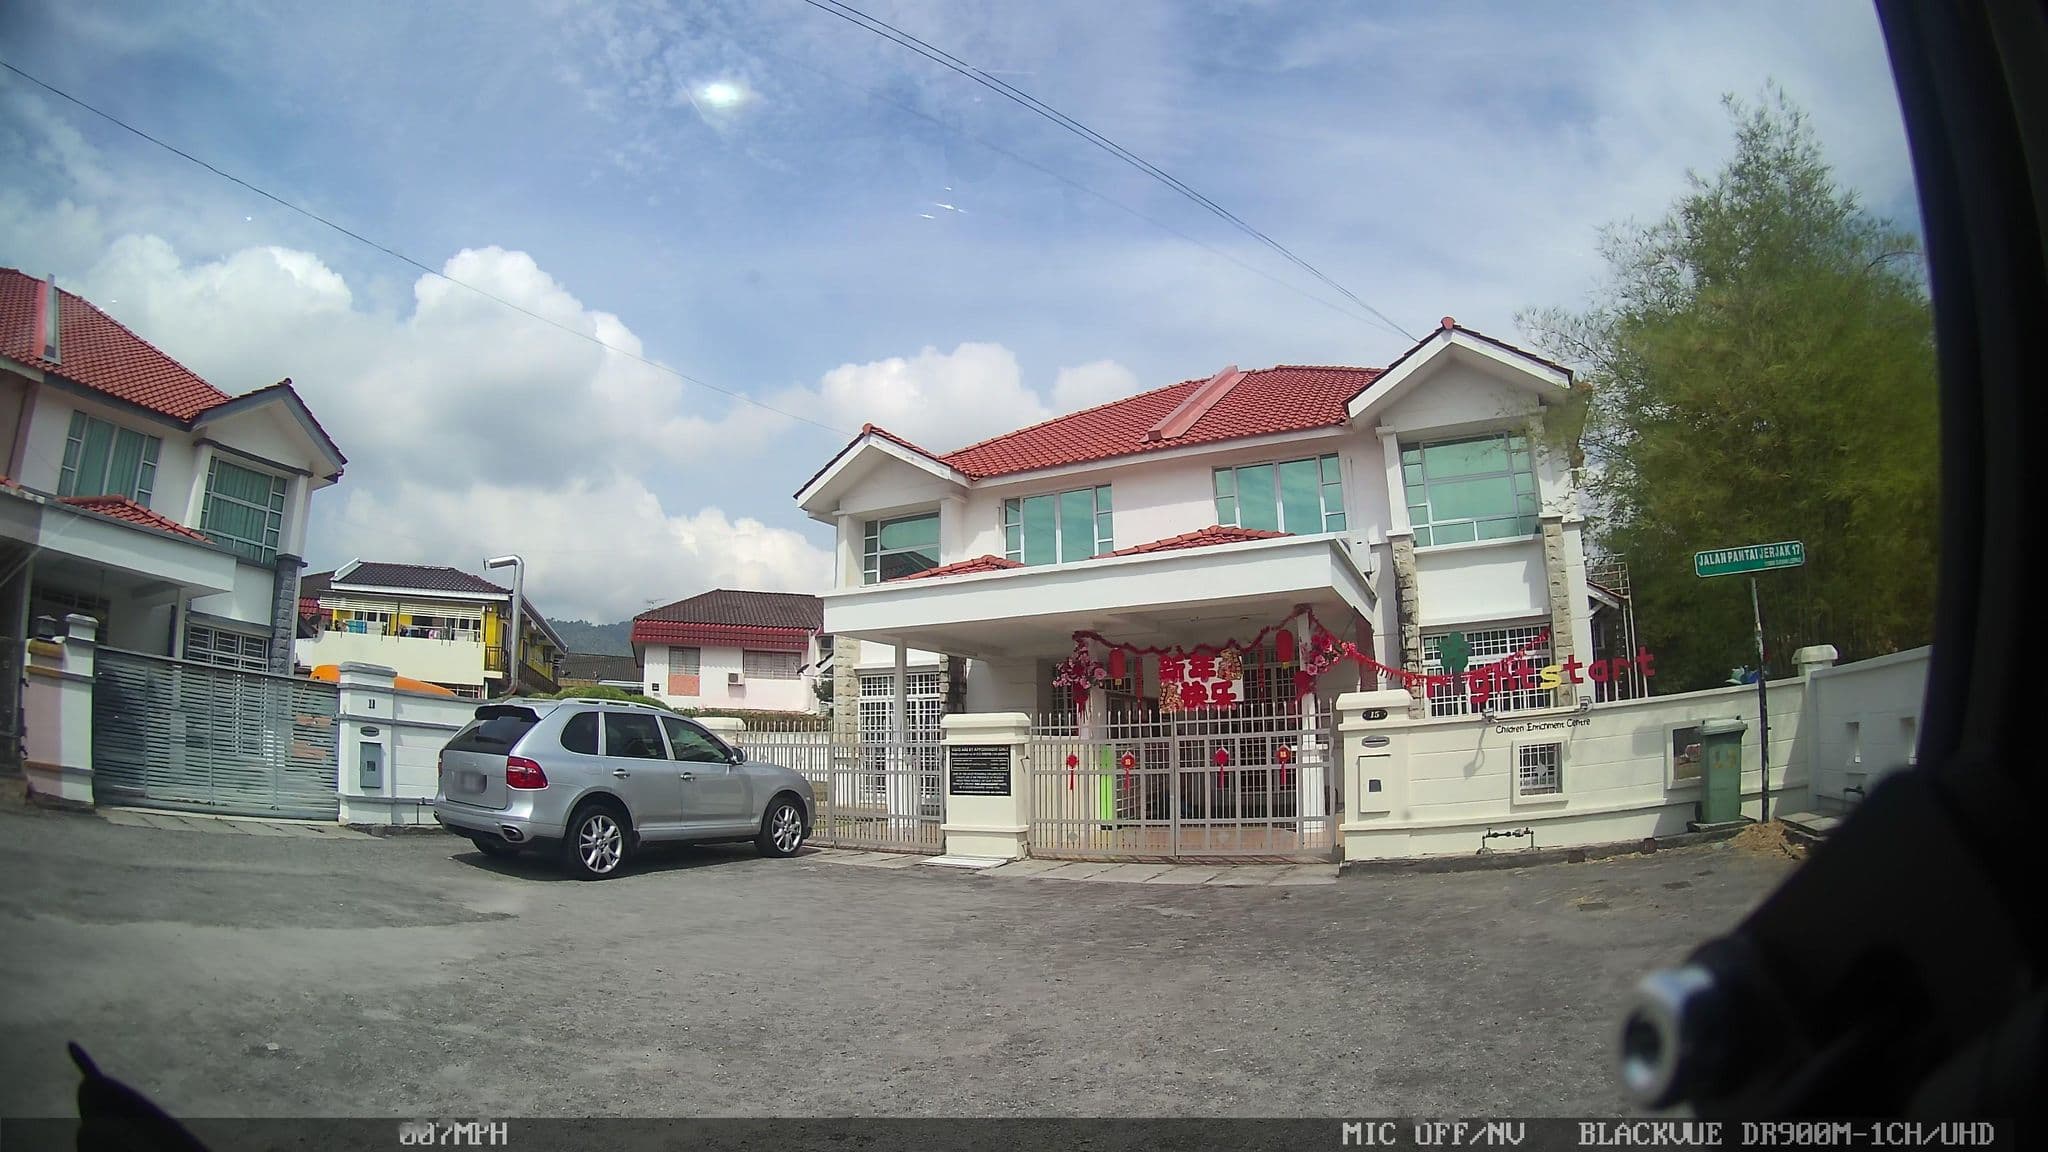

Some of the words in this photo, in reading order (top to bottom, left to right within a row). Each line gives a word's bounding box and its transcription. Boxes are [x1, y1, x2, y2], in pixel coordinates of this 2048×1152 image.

[1698, 551, 1727, 566] JALAN
[1727, 548, 1758, 563] PANTAI
[1760, 545, 1791, 559] JERJAK
[1792, 544, 1800, 556] 17
[1159, 655, 1217, 683] 新年
[1181, 680, 1237, 709] 快乐
[1370, 711, 1380, 719] 15
[1495, 725, 1525, 734] Children
[1526, 722, 1565, 732] Enrichment
[1566, 718, 1591, 728] Centre
